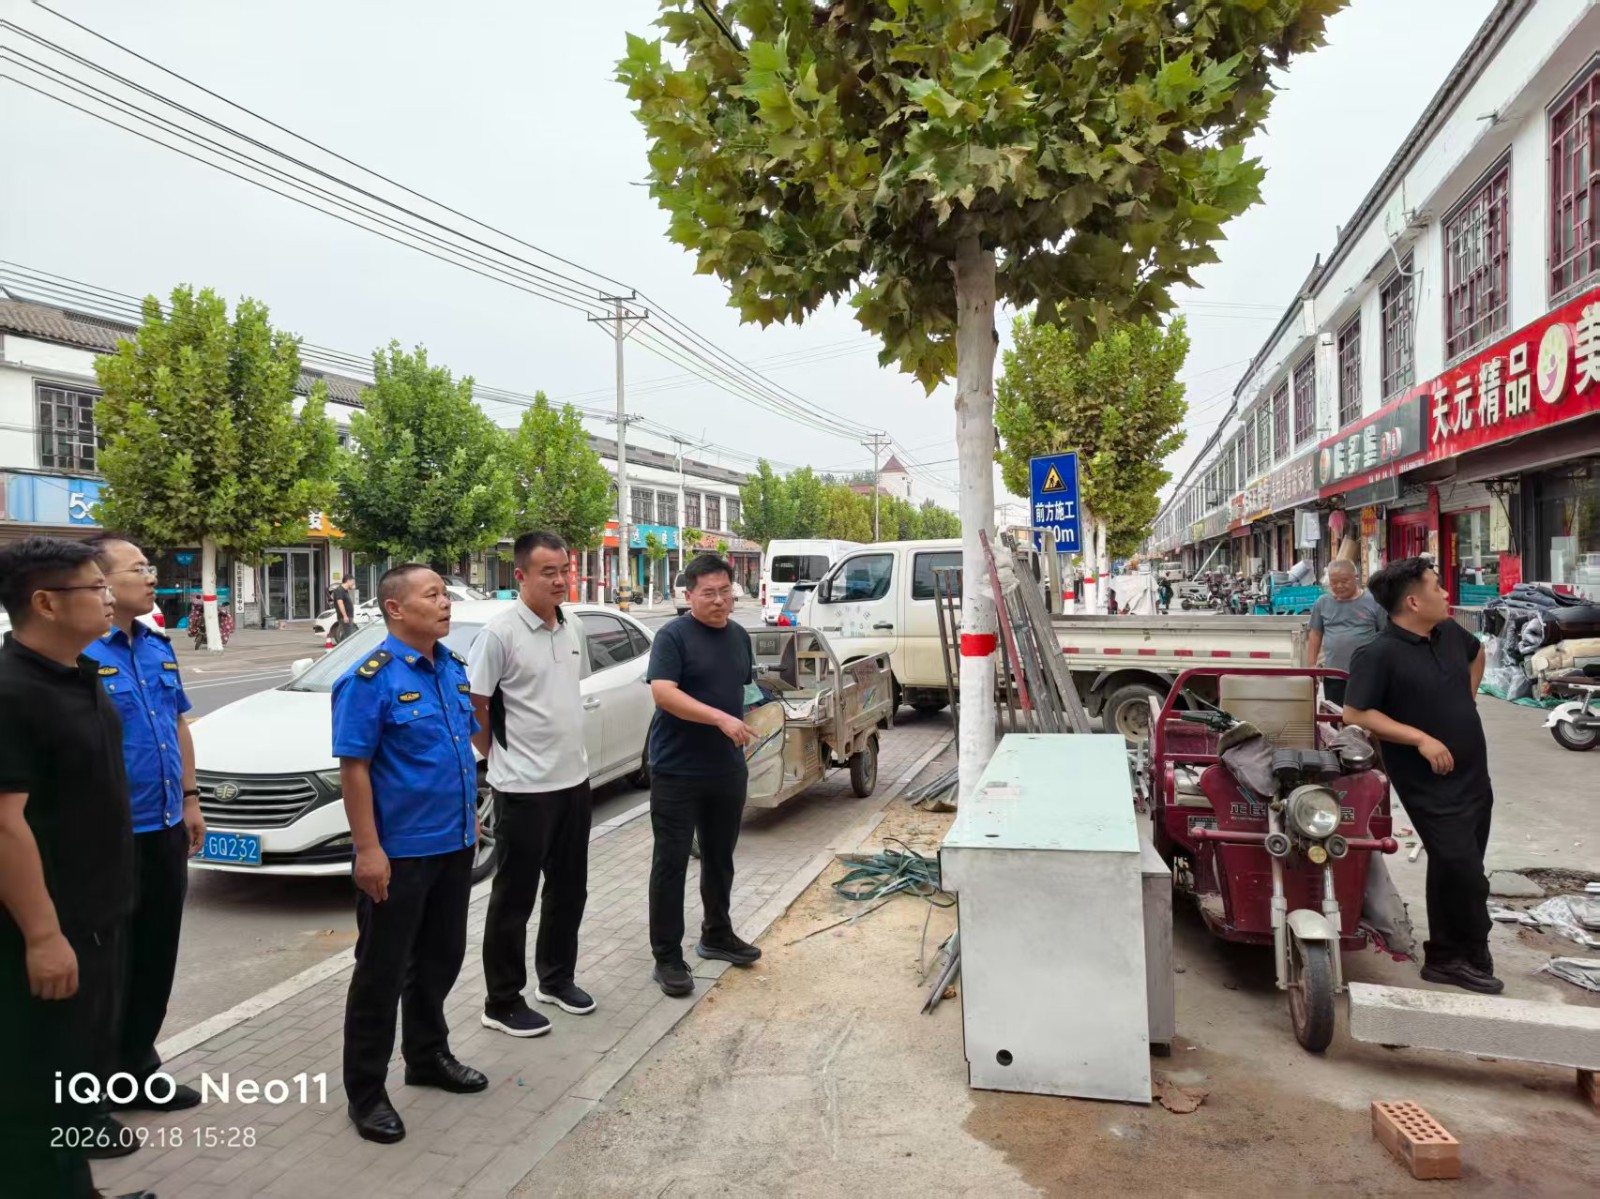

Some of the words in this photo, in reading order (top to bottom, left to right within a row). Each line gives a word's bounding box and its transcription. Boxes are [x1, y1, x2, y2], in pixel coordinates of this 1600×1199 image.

[1432, 341, 1531, 444] 天元精品
[1035, 500, 1075, 523] 前方施工
[1038, 525, 1075, 543] 0m
